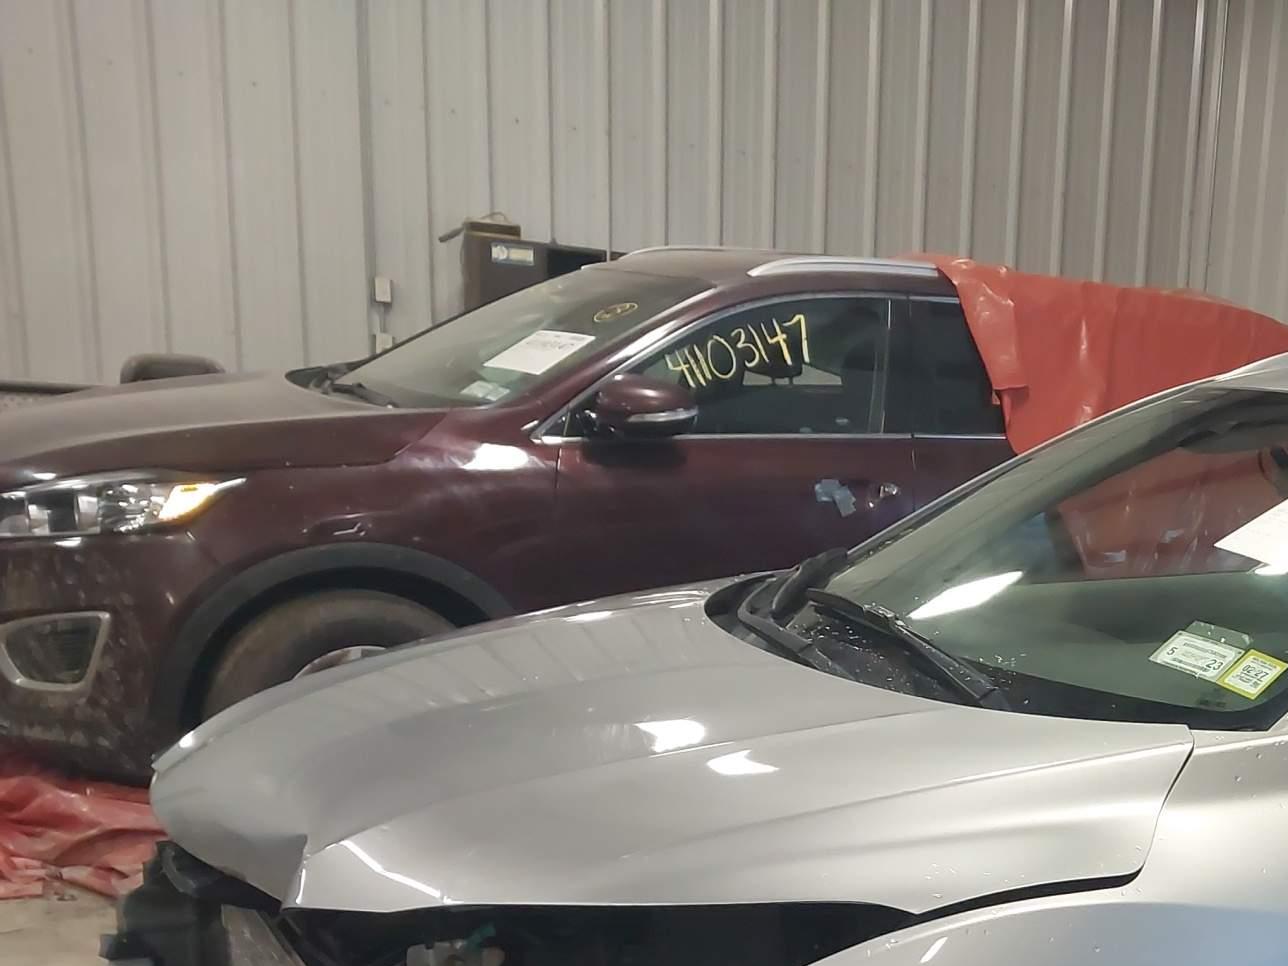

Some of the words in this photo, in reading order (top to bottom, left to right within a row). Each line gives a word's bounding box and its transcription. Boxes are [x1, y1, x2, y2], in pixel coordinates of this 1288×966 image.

[664, 314, 810, 389] 41103147
[1166, 646, 1179, 656] 5
[1205, 658, 1224, 671] 23
